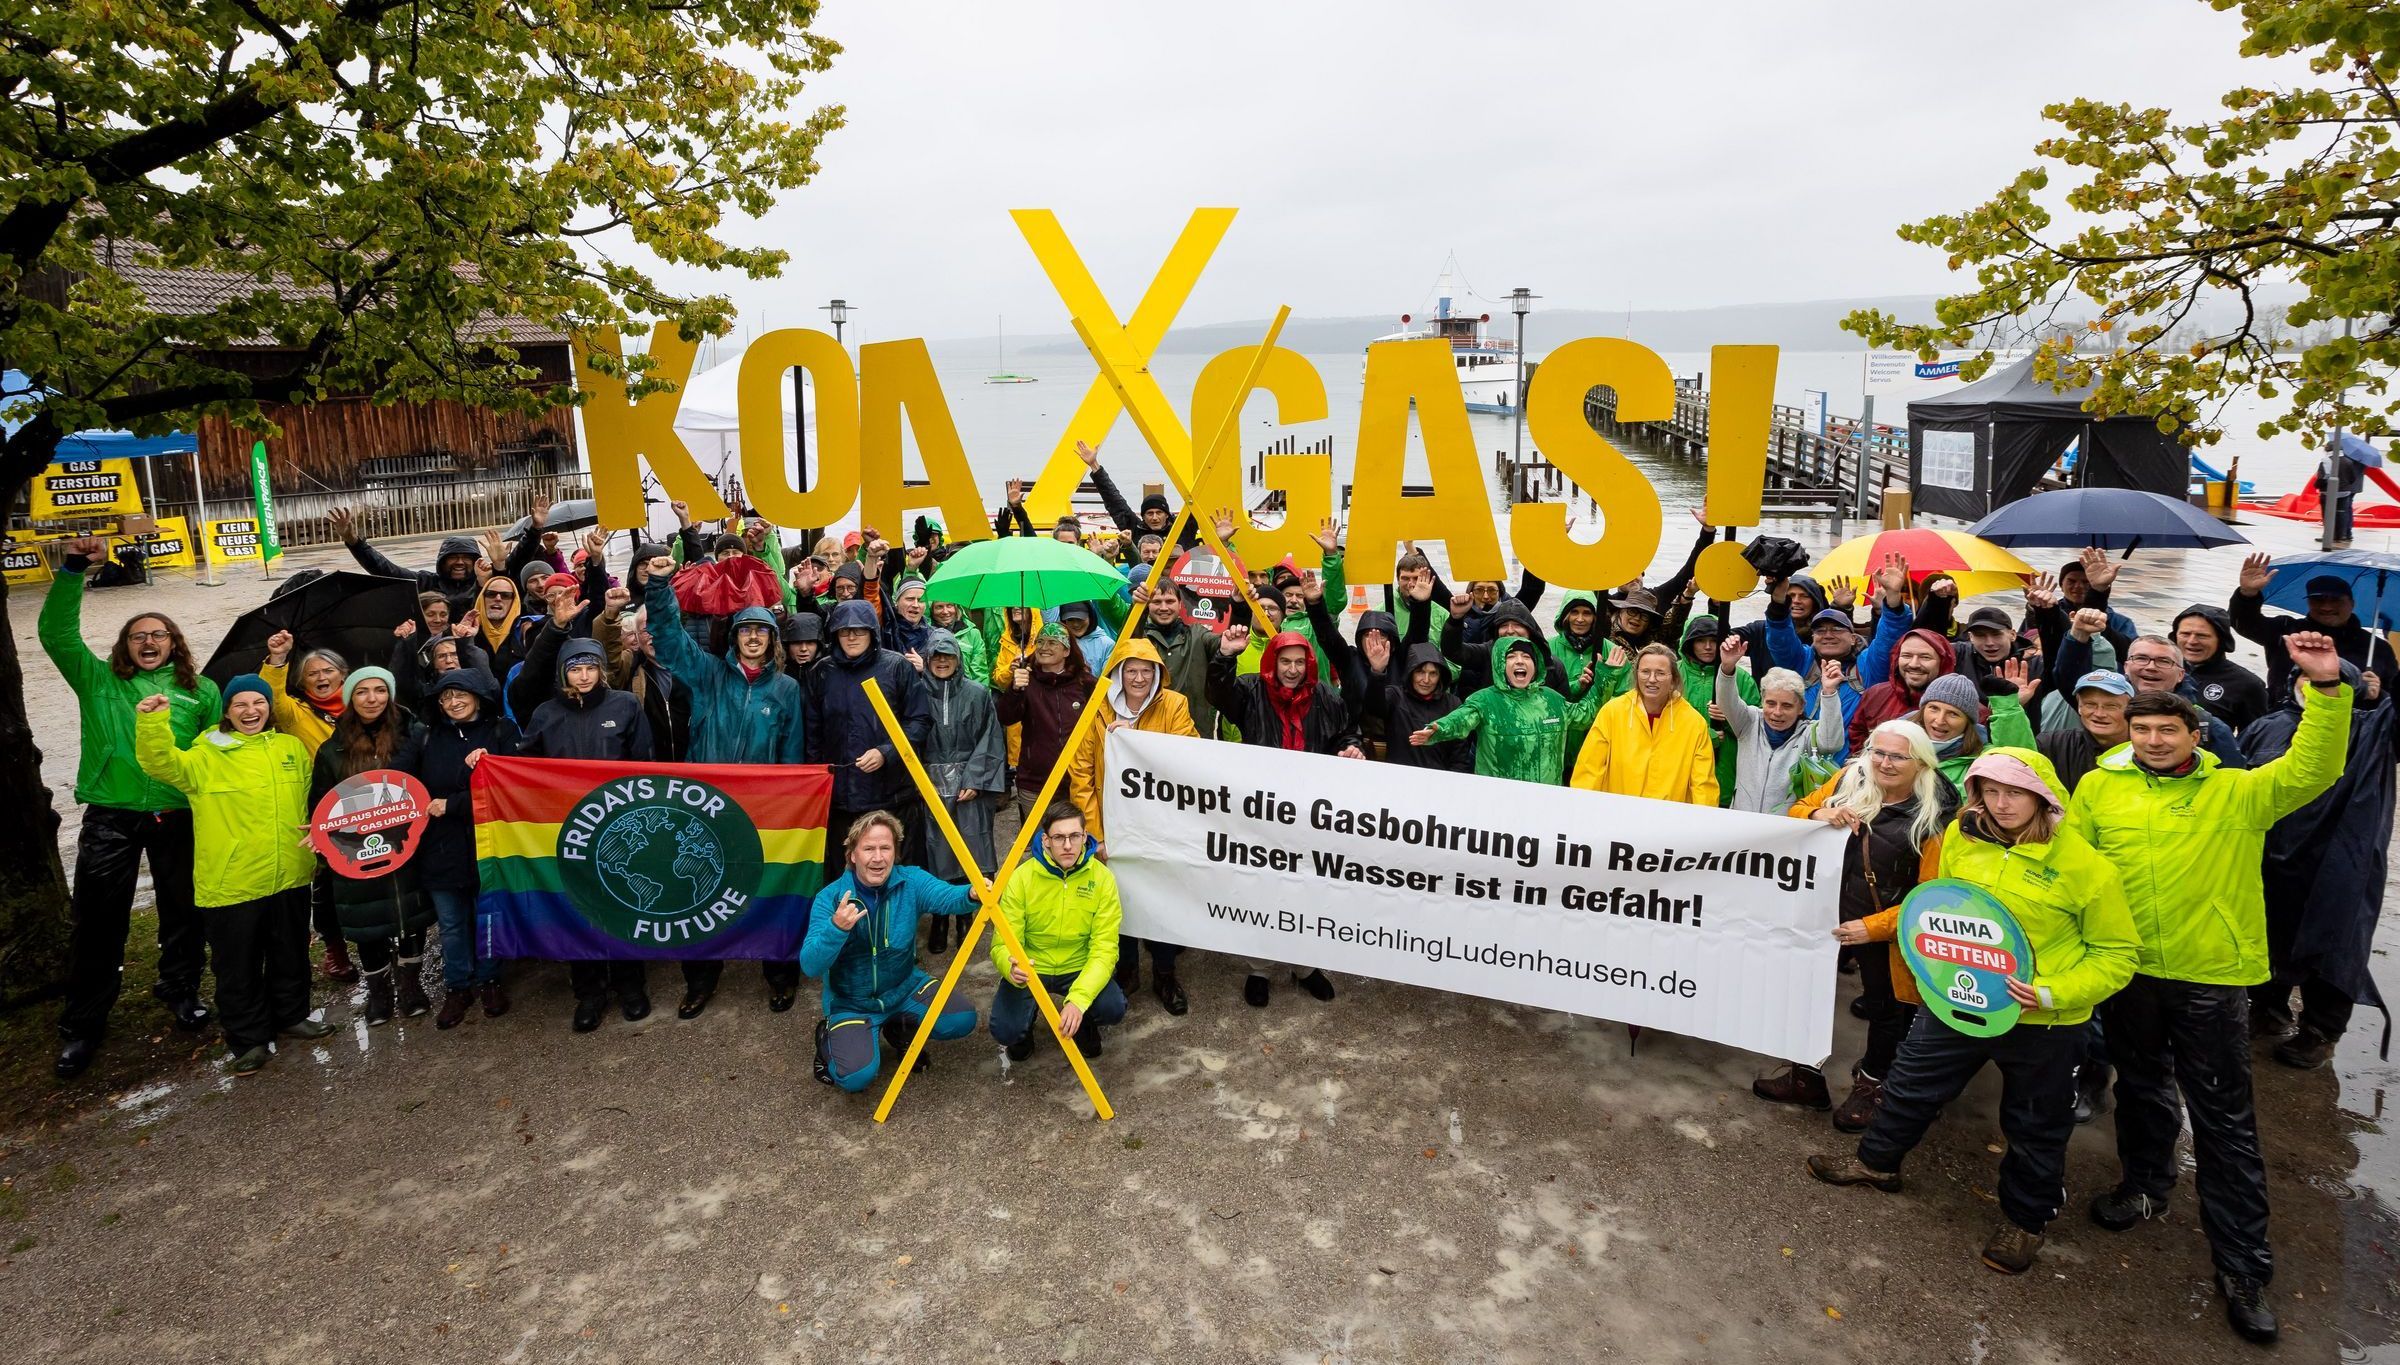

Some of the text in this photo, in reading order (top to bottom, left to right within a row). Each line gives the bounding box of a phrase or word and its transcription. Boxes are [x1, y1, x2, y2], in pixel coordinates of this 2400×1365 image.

[69, 461, 97, 472] GAS
[571, 321, 994, 548] KOA
[1191, 337, 1780, 602] GAS!
[51, 475, 117, 490] ZERSTÖRT
[57, 491, 115, 505] BAYERN!
[254, 457, 279, 547] GREENPEACE
[222, 522, 250, 533] KEIN
[150, 540, 181, 555] GAS!
[218, 534, 257, 546] NEUES
[225, 546, 255, 556] GAS!
[4, 554, 38, 568] GAS!
[1173, 575, 1193, 583] RAUS
[1214, 588, 1231, 596] UND
[1194, 610, 1215, 618] BUND
[319, 802, 410, 831] RAUS AUS KOHLE,
[360, 810, 422, 832] GAS UND ÖL
[563, 778, 726, 860] FRIDAYS FOR
[1120, 767, 1817, 892] Stoppt die Gasbohrung in Reichling!
[360, 846, 389, 858] BUND
[1206, 831, 1703, 927] Unser Wasser ist in Gefahr!
[633, 887, 748, 942] FUTURE
[1928, 916, 1993, 939] KLIMA
[1207, 902, 1698, 998] www.BI-ReichlingLudenhausen.de
[1924, 938, 2007, 970] RETTEN!
[1951, 989, 1984, 1005] BUND
